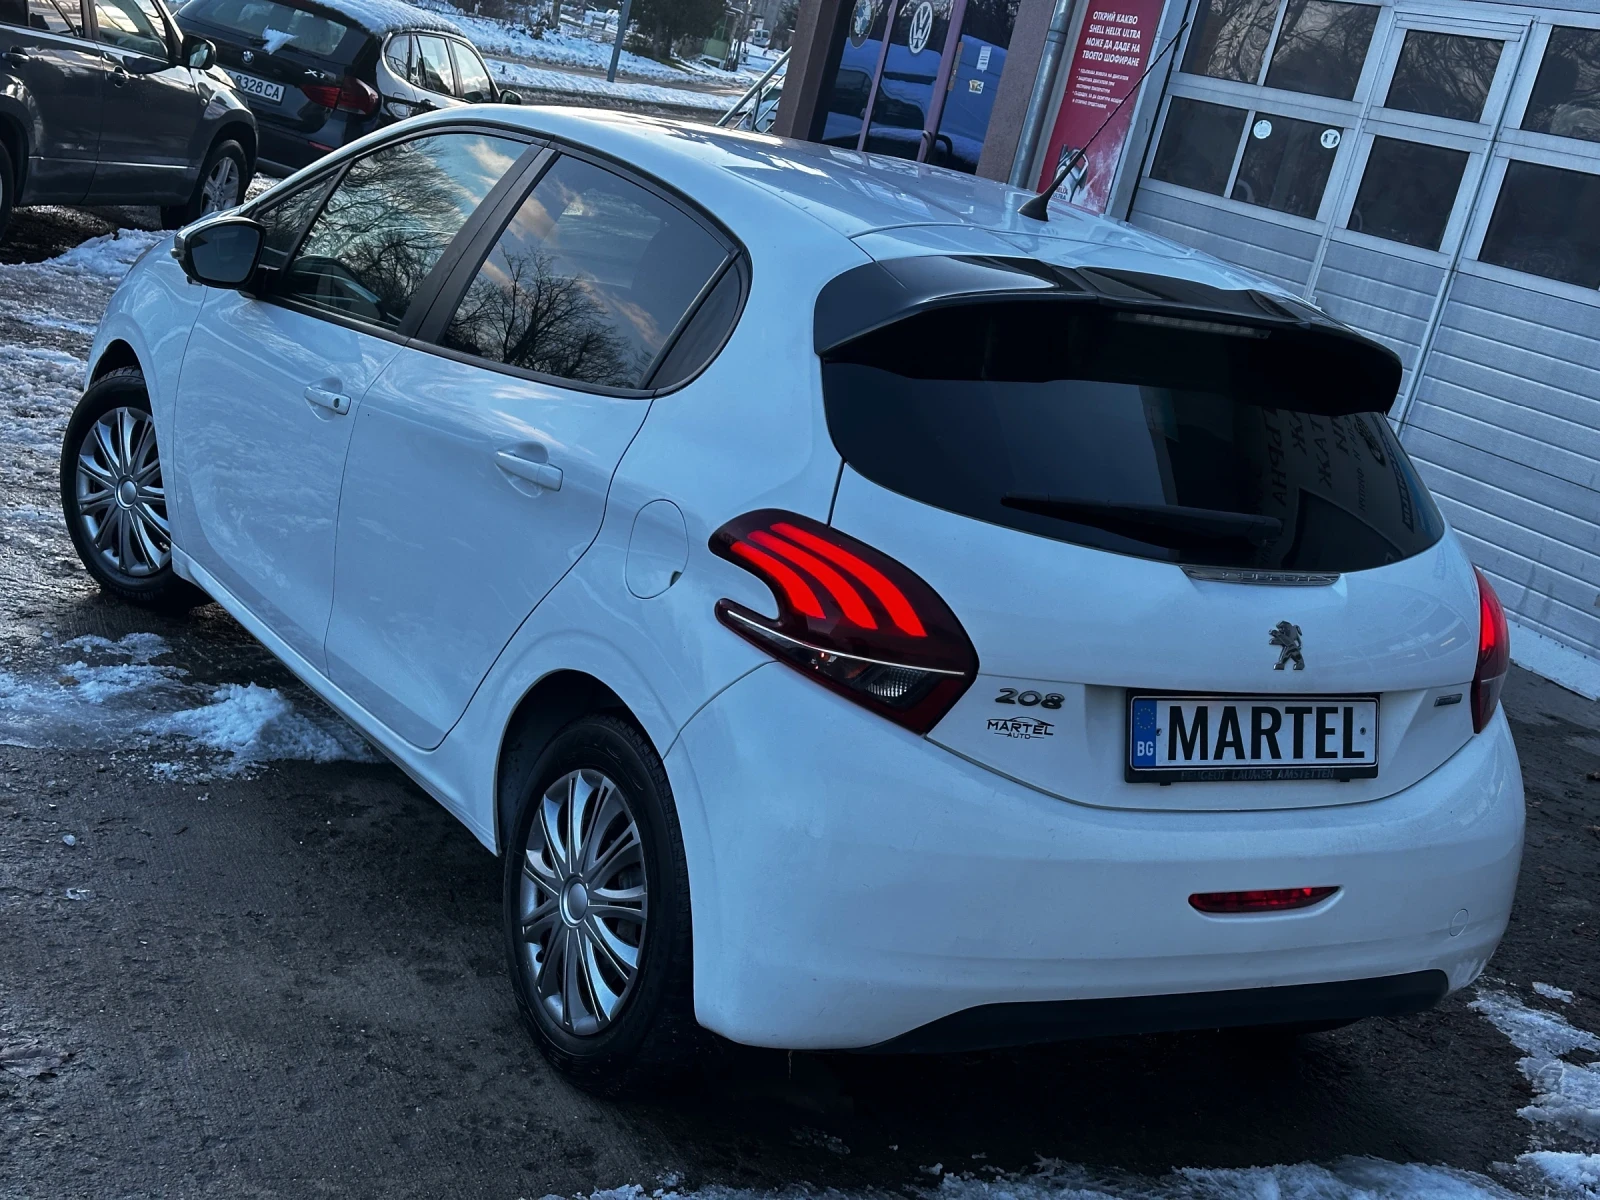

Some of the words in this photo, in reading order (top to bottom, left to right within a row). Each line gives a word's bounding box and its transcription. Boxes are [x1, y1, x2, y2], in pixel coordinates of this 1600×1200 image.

[1093, 10, 1115, 21] ОТКРИЙ
[1116, 14, 1138, 24] КАКВО
[1089, 24, 1104, 34] SHELL
[1105, 26, 1121, 37] HELIX
[1122, 28, 1140, 39] ULTRA
[1085, 37, 1104, 48] МОЖЕ
[1103, 40, 1113, 50] ДА
[1113, 41, 1131, 52] ДАДЕ
[1131, 43, 1140, 53] НА
[1082, 50, 1103, 61] ТВОЕТО
[1104, 52, 1140, 67] ШОФИРАНЕ
[994, 687, 1065, 709] 208
[987, 720, 1054, 736] MARTEL
[1007, 732, 1031, 740] AUTO
[1167, 705, 1365, 761] MARTEL
[1137, 741, 1154, 757] BG
